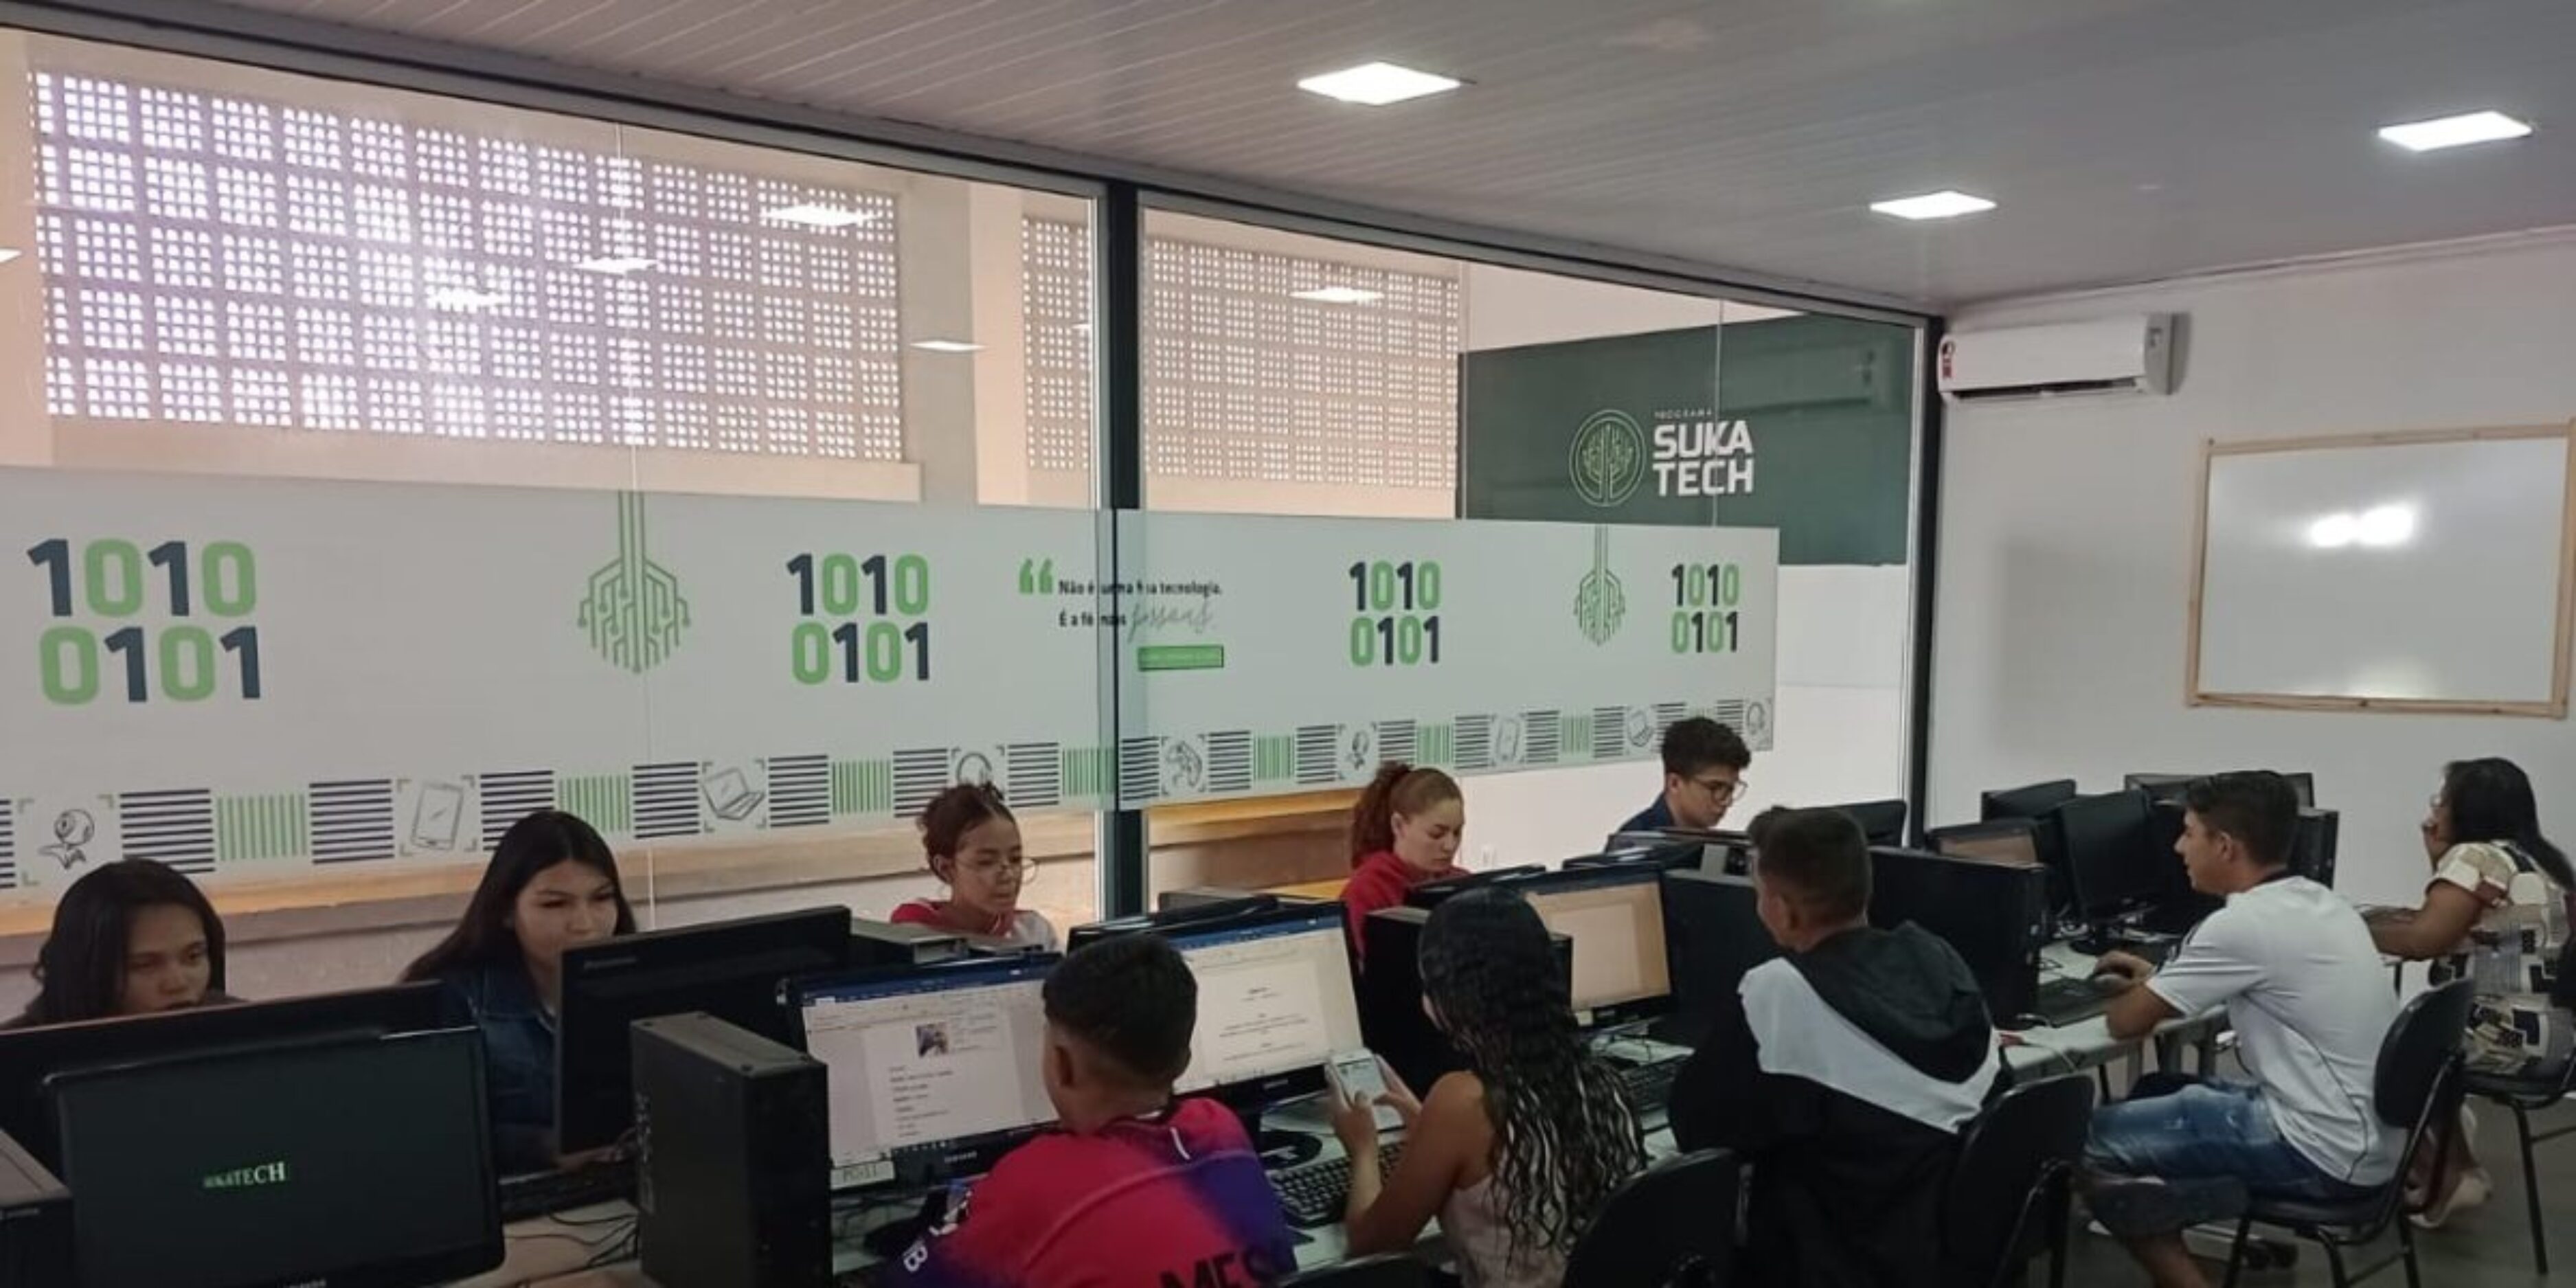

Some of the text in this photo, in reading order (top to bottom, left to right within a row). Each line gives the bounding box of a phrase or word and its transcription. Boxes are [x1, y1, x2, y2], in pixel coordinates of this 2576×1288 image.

[1653, 420, 1754, 460] SUKA
[1653, 457, 1754, 497] TECH
[27, 539, 256, 618] 1010
[786, 553, 929, 615] 1010
[1059, 579, 1084, 595] Não
[1088, 580, 1094, 595] é
[1160, 578, 1221, 598] tecnologia.
[1349, 561, 1442, 611] 1010
[1671, 563, 1740, 607] 1010
[1059, 608, 1067, 627] É
[1071, 615, 1078, 626] a
[1350, 615, 1441, 667] 0101
[1672, 611, 1739, 654] 0101
[39, 626, 261, 705] 0101
[791, 622, 930, 684] 0101
